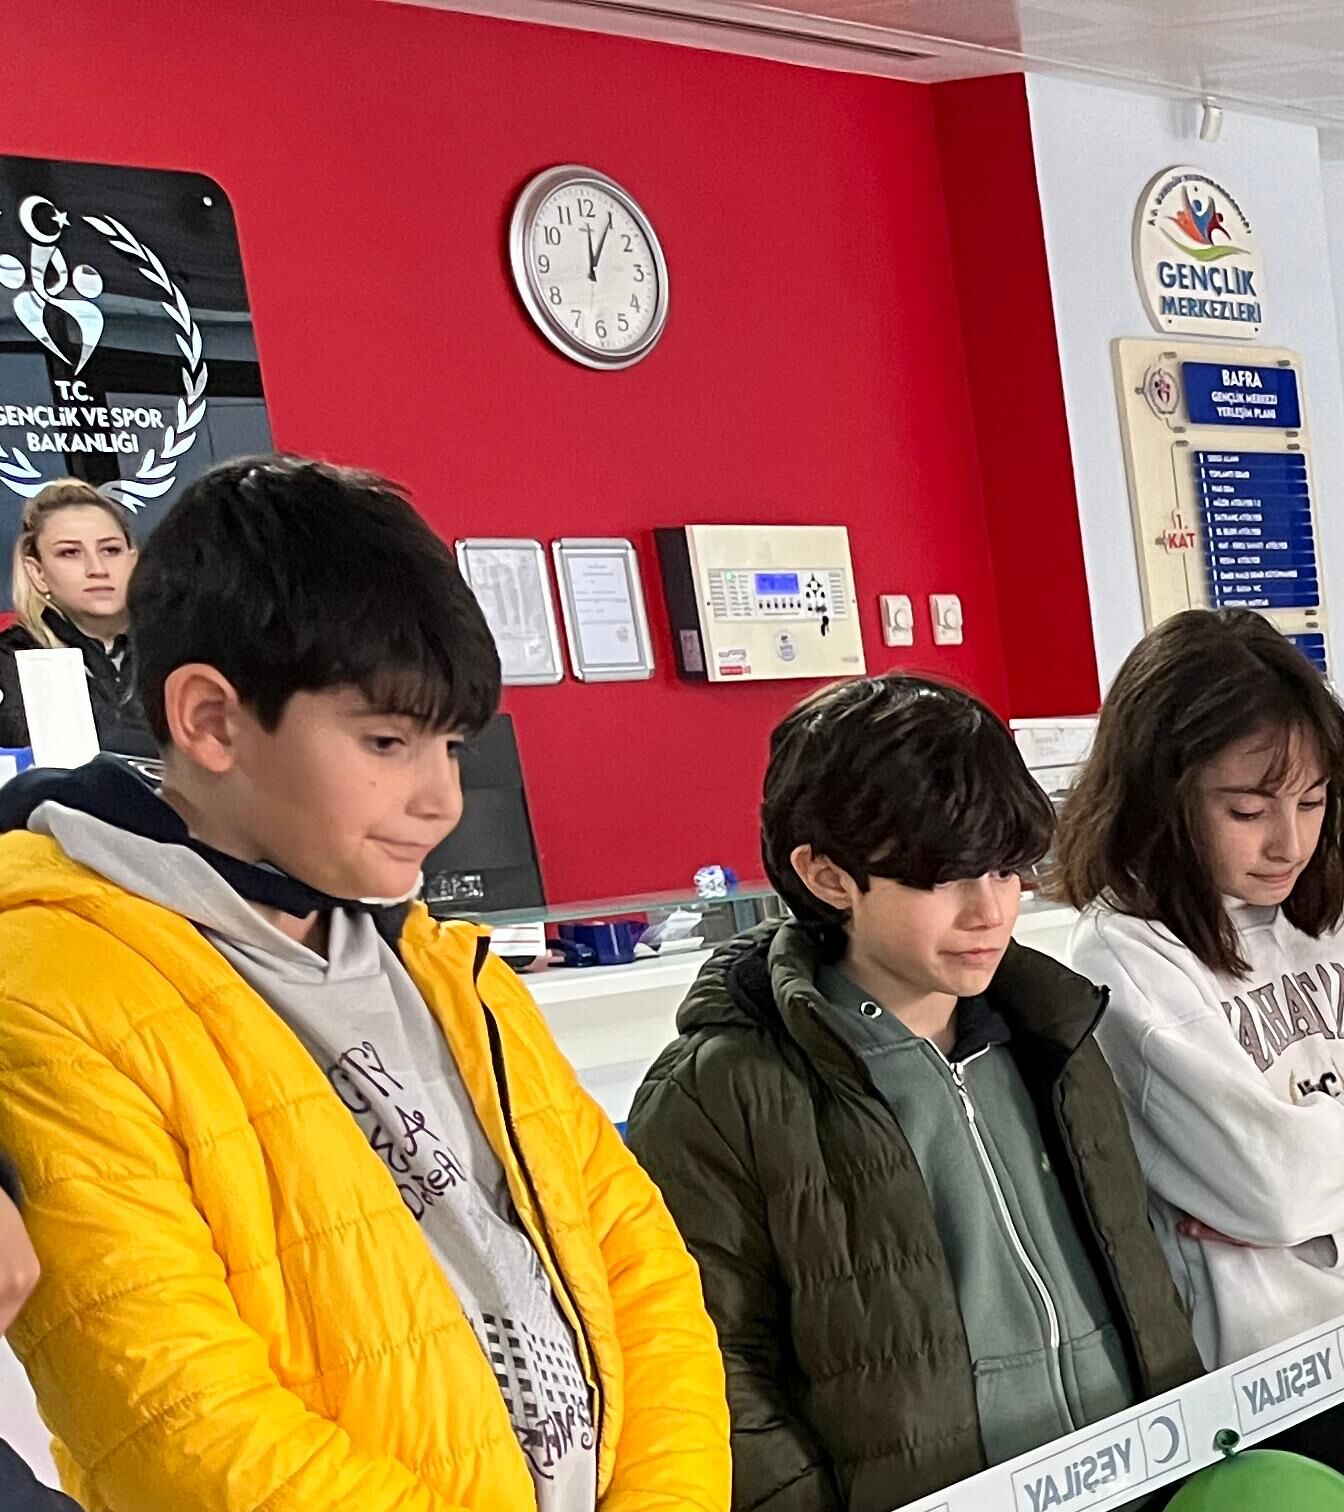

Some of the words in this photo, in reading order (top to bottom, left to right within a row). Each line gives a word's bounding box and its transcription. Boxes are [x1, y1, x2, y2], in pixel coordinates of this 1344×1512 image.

[557, 205, 572, 226] 11
[577, 198, 596, 218] 12
[543, 226, 561, 246] 10
[620, 234, 633, 253] 2
[537, 254, 550, 274] 9
[633, 264, 644, 283] 3
[1157, 260, 1257, 297] GENÇLİK
[549, 286, 562, 305] 8
[630, 293, 641, 313] 4
[570, 309, 582, 329] 7
[1160, 295, 1262, 324] MERKEZLERİ
[595, 319, 607, 339] 6
[617, 313, 629, 332] 5
[1221, 368, 1263, 389] BAFRA
[54, 380, 95, 401] T.C.
[80, 406, 111, 427] VE
[110, 407, 164, 429] SPOR
[26, 430, 140, 453] BAKANLIĞI
[1167, 532, 1196, 549] KAT
